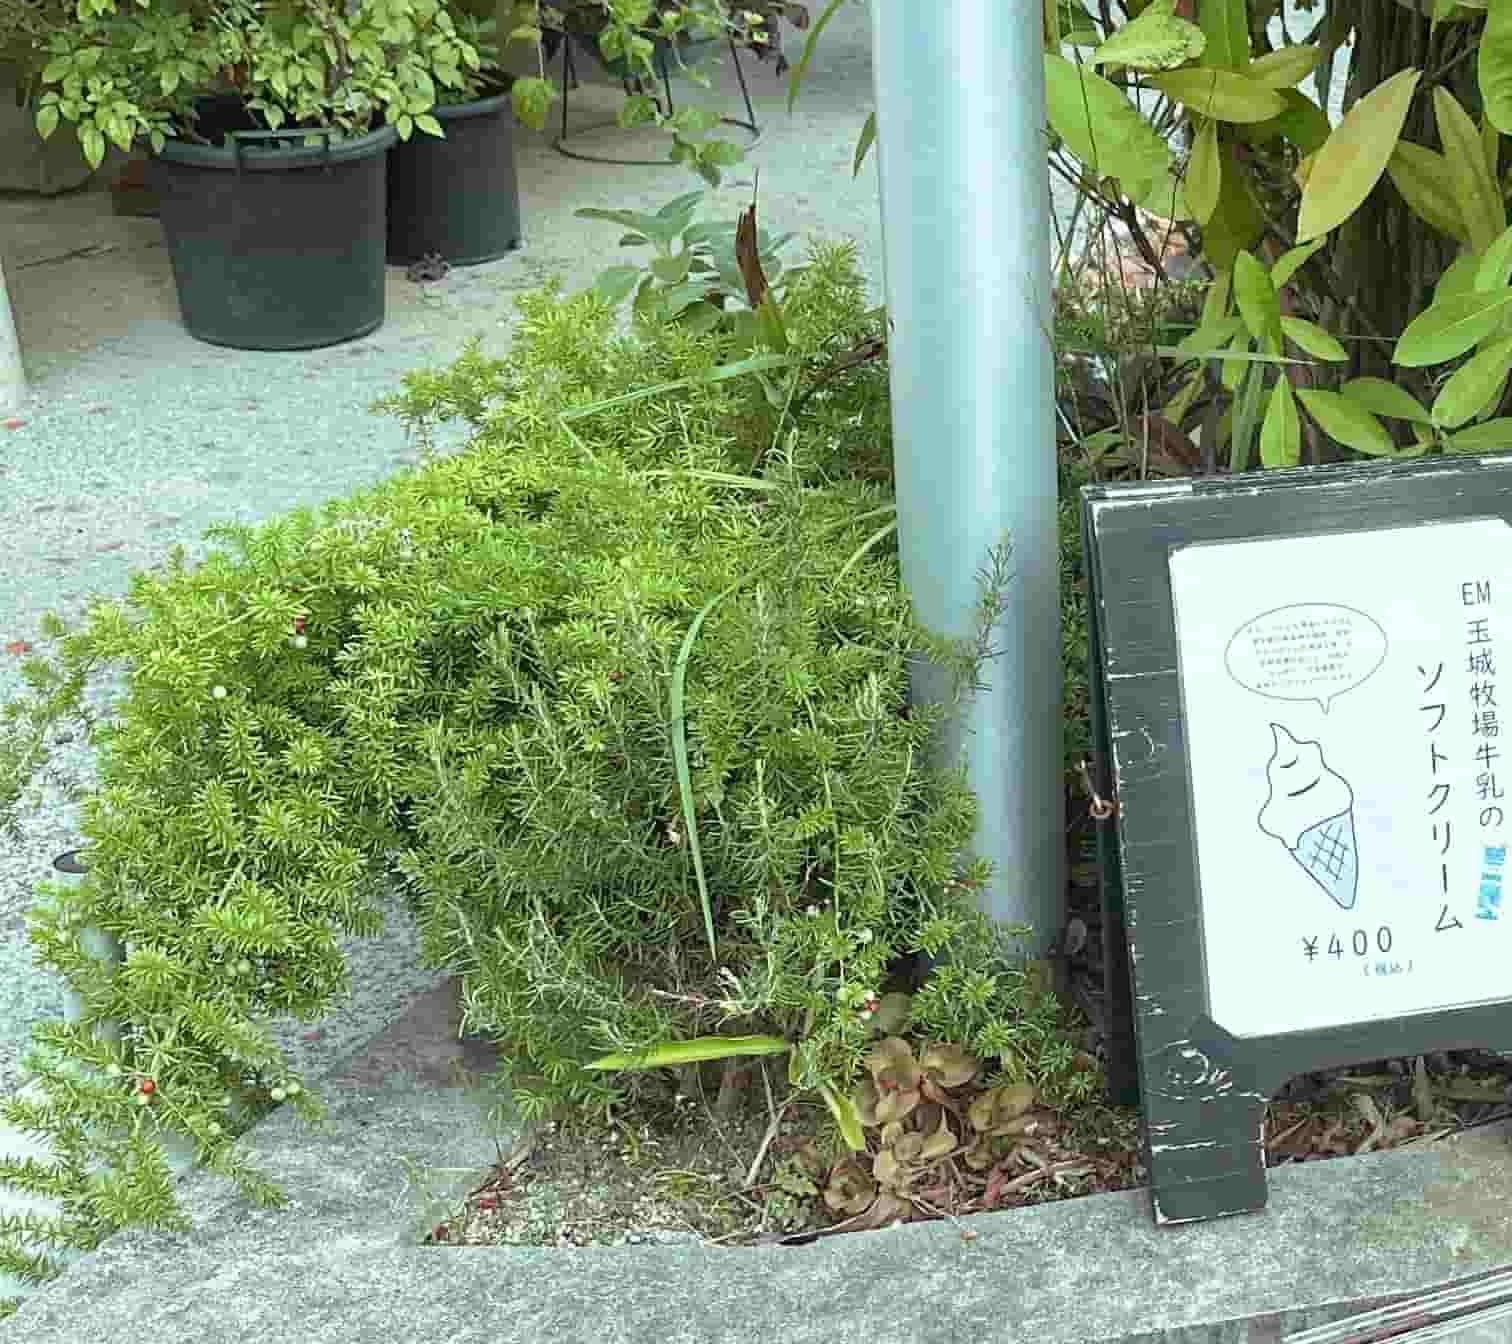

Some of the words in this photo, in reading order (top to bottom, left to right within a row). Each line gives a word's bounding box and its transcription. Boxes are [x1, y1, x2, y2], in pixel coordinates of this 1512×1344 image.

[1417, 660, 1464, 932] ソフトクリーム
[1302, 925, 1392, 962] ¥400
